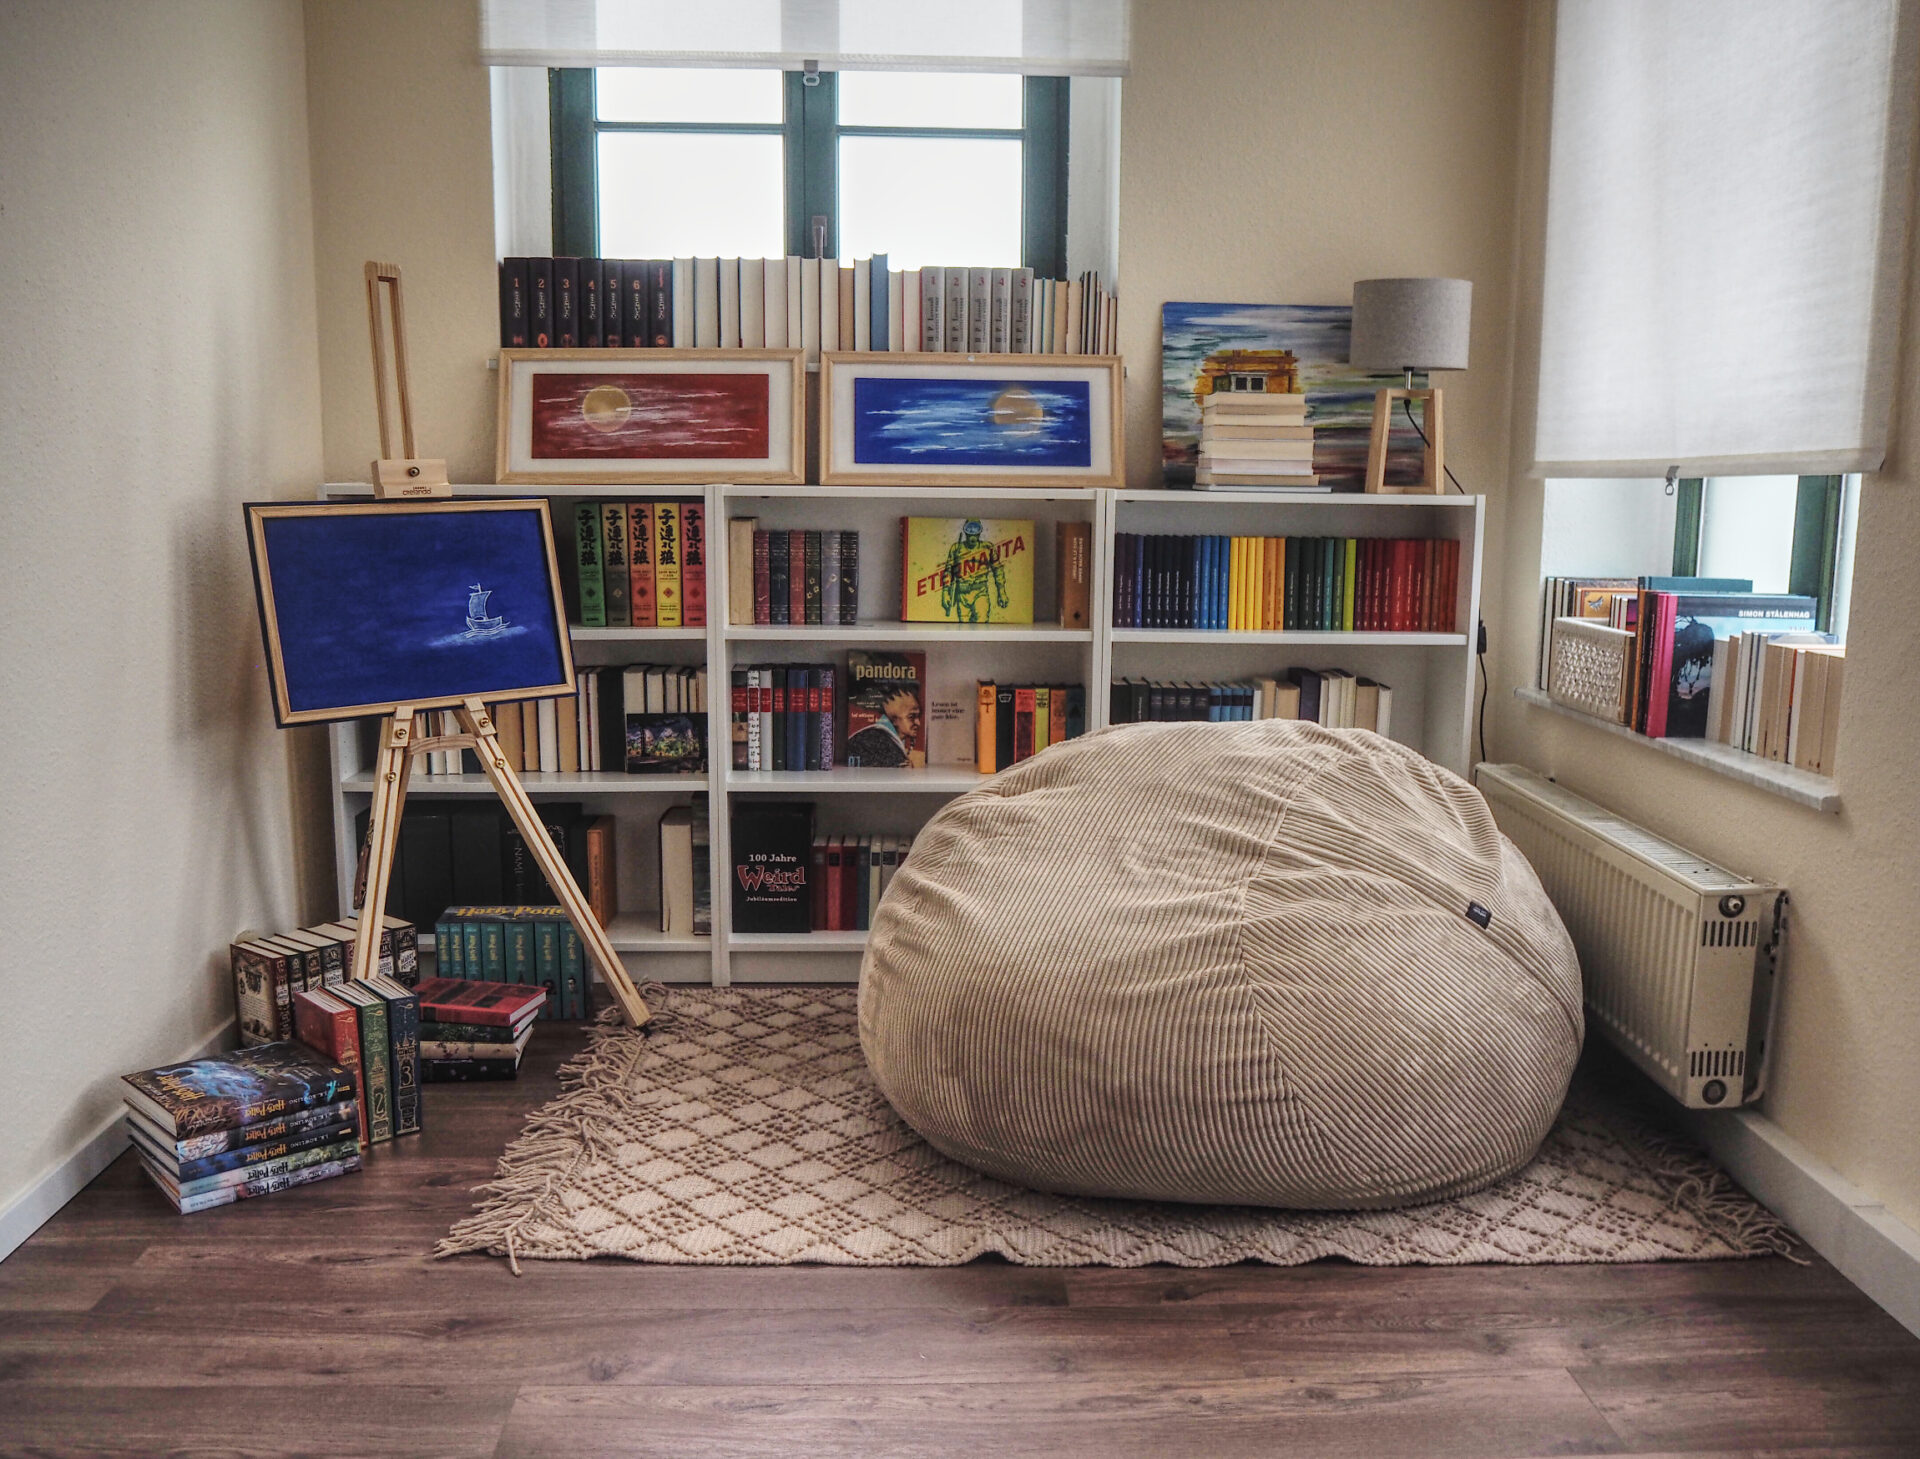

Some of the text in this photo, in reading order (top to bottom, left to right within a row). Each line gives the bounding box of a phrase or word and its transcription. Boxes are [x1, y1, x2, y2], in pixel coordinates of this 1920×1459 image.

[514, 278, 520, 288] 1
[538, 278, 544, 288] 2
[563, 278, 570, 288] 3
[588, 280, 595, 290] 4
[610, 280, 616, 289] 5
[633, 280, 640, 290] 6
[916, 536, 1026, 597] ETERNAUTA
[1765, 608, 1810, 618] STÅLENHAG
[856, 662, 916, 680] pandora
[749, 854, 797, 862] 100 Jahre
[737, 865, 806, 892] Weird
[456, 905, 565, 920] Harry Potte
[402, 1065, 412, 1086] 3
[267, 1100, 286, 1112] Harry
[374, 1093, 384, 1114] 2
[245, 1104, 265, 1117] Potter
[290, 1116, 317, 1127] ROWLING
[245, 1126, 266, 1140] Potter
[268, 1122, 286, 1136] Harry
[290, 1137, 318, 1148] ROWLING
[246, 1148, 267, 1162] Potter
[269, 1143, 287, 1156] Harry
[247, 1166, 269, 1179] Potter
[270, 1161, 288, 1174] Harry
[247, 1182, 269, 1195] Potter
[271, 1177, 290, 1190] Harry
